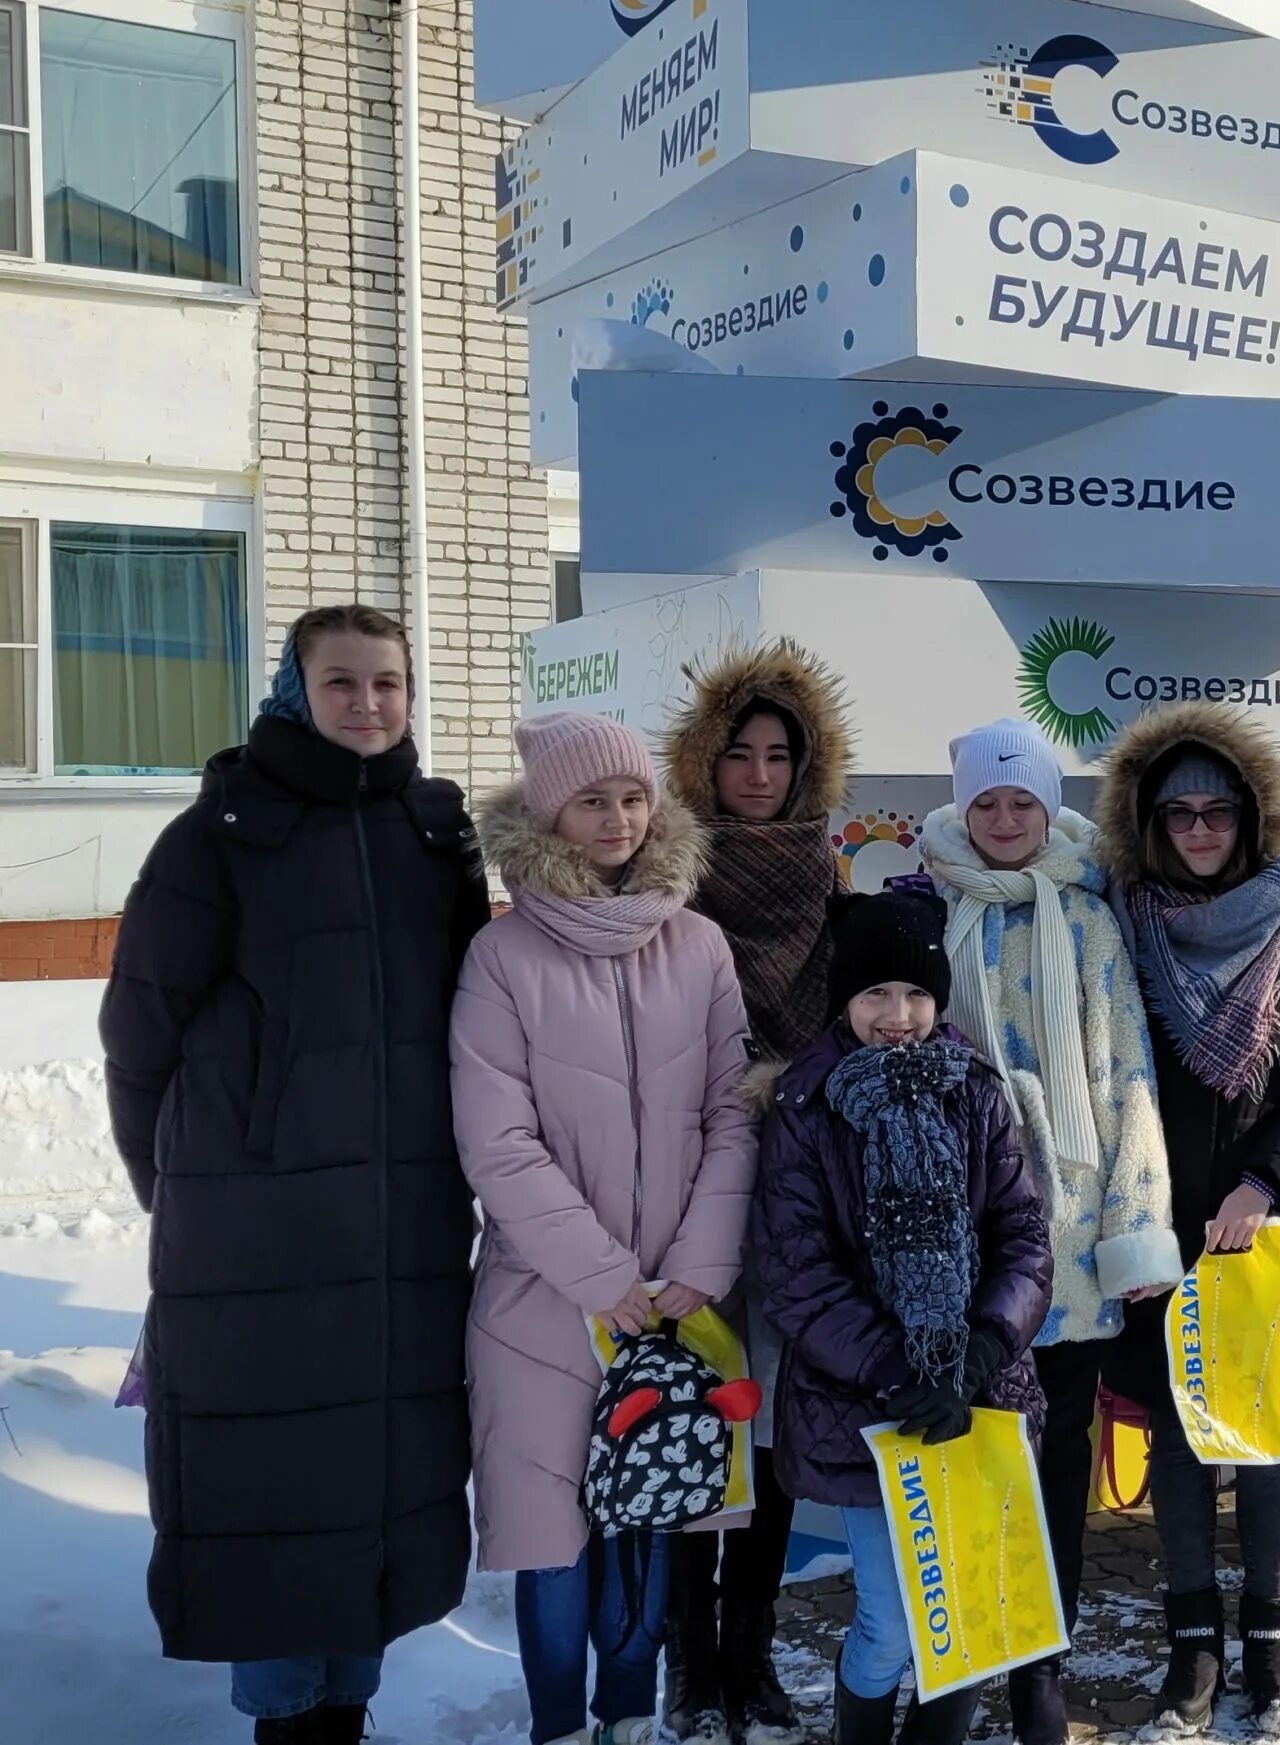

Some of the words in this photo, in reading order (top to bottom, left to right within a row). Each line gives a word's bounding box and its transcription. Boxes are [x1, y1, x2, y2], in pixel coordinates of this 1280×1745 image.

[620, 18, 719, 140] МЕНЯЕМ
[659, 90, 721, 177] МИР!
[988, 205, 1270, 298] СОЗДАЕМ
[671, 284, 808, 351] Созвездие
[948, 463, 1236, 512] Созвездие
[536, 648, 619, 704] БЕРЕЖЕМ
[1181, 1264, 1212, 1435] СОЗВЕЗДИ
[898, 1455, 951, 1657] СОЗВЕЗДИЕ
